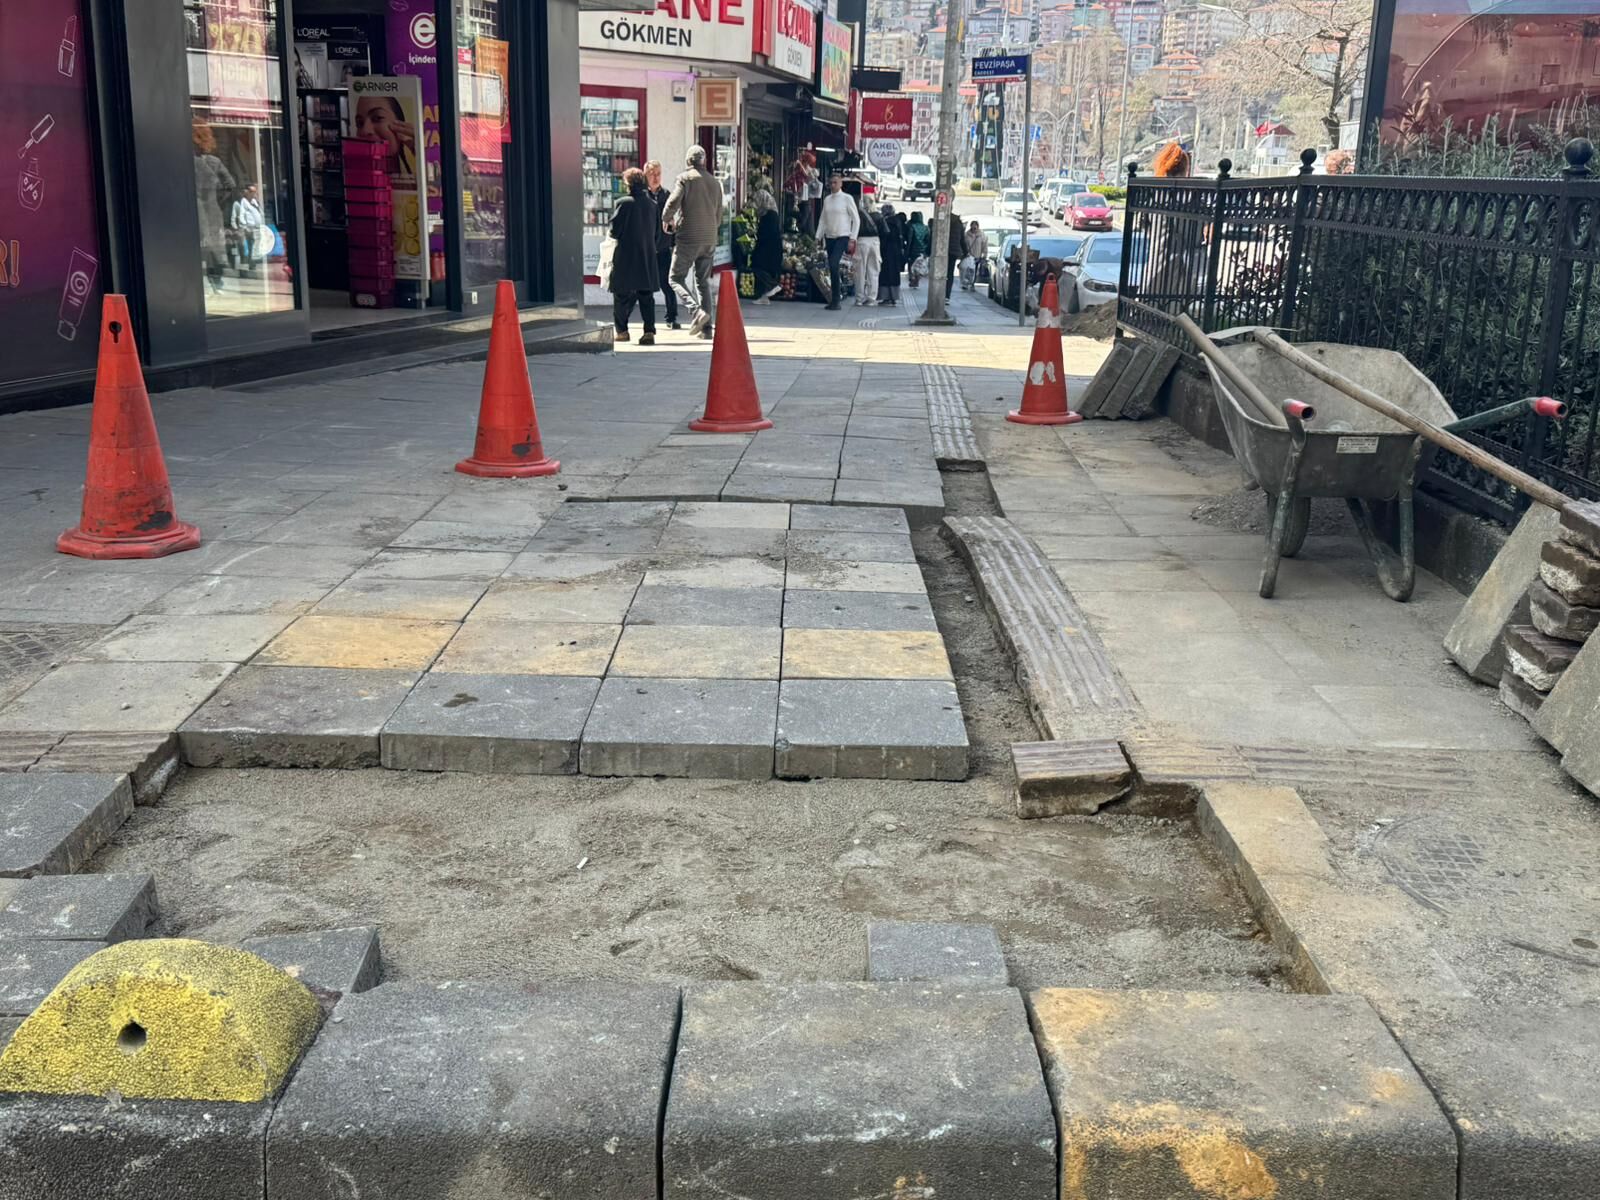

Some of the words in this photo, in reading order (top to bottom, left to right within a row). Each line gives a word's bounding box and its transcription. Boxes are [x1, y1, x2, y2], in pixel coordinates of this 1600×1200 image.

[600, 17, 692, 47] GÖKMEN
[975, 59, 1016, 70] FEVZİPAŞA
[706, 87, 729, 115] E
[873, 142, 898, 150] AKEL
